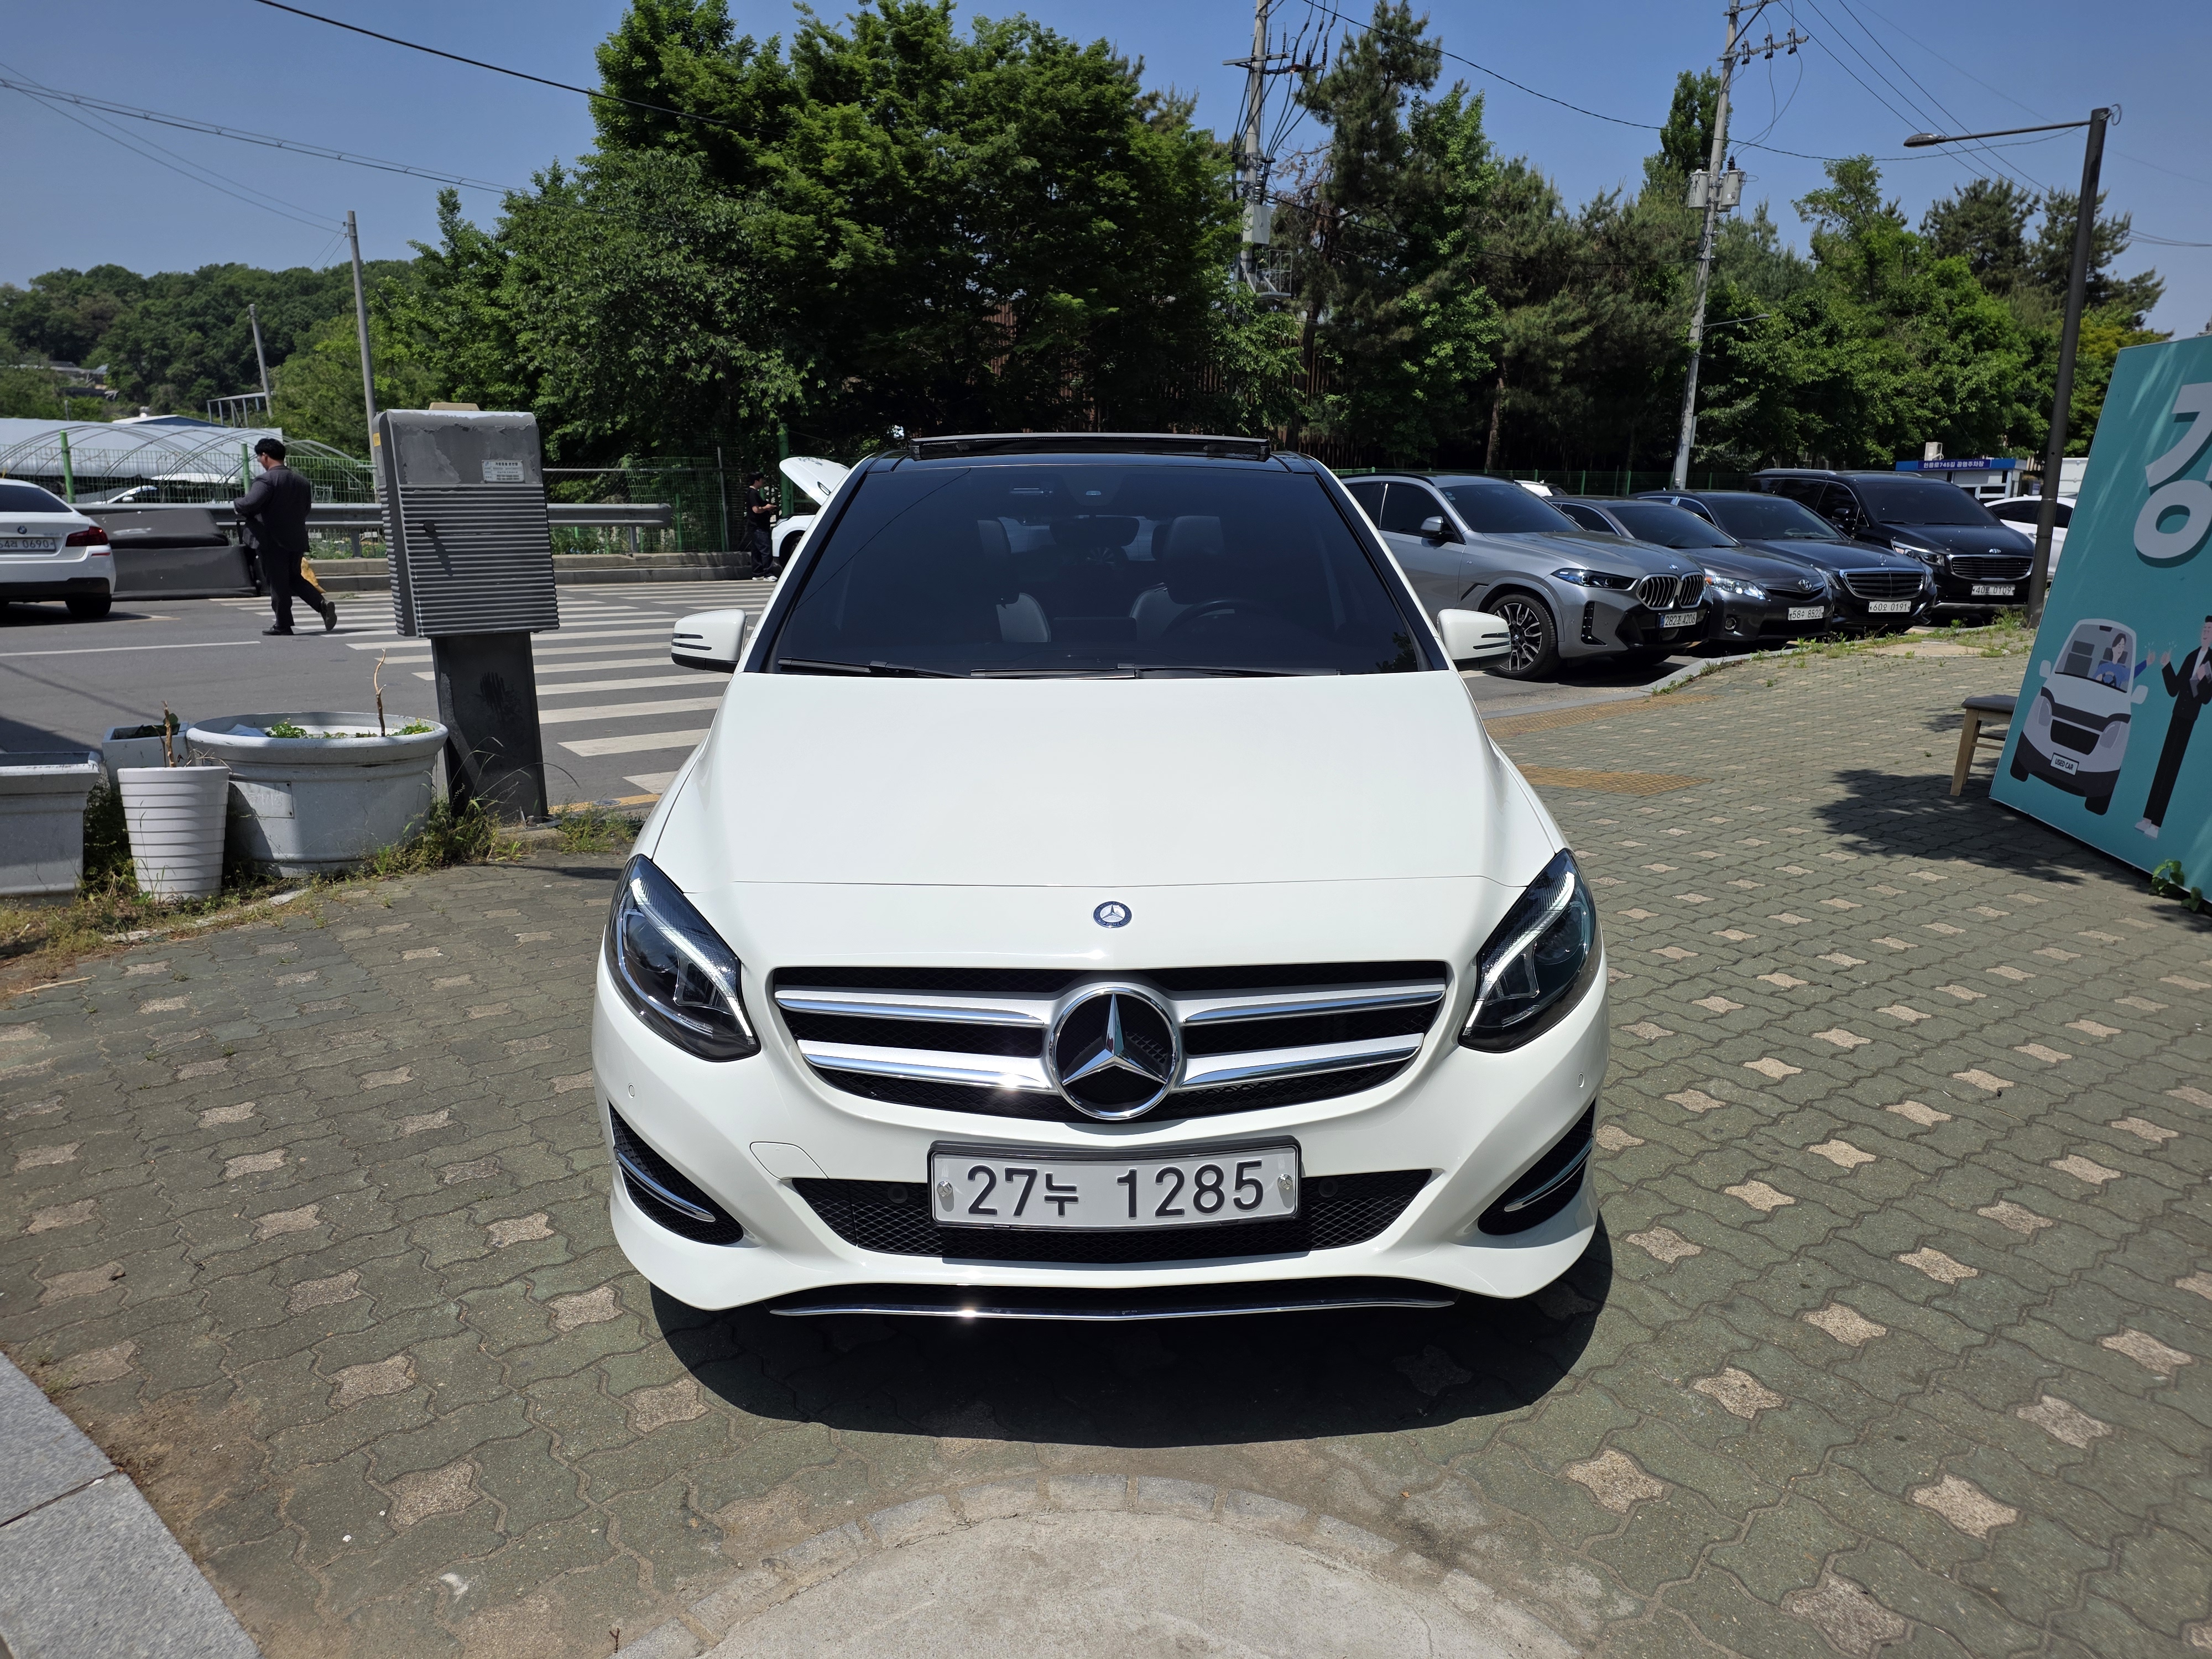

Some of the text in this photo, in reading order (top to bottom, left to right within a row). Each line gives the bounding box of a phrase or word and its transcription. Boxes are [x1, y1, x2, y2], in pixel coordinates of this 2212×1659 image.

[23, 539, 49, 548] 0690
[1994, 586, 2011, 594] 0109
[1891, 603, 1907, 611] 0191
[1792, 608, 1822, 618] 58수 8522
[1682, 613, 1695, 624] 4206
[2054, 758, 2074, 771] USED CAR
[967, 1160, 1264, 1219] 27누 1285
